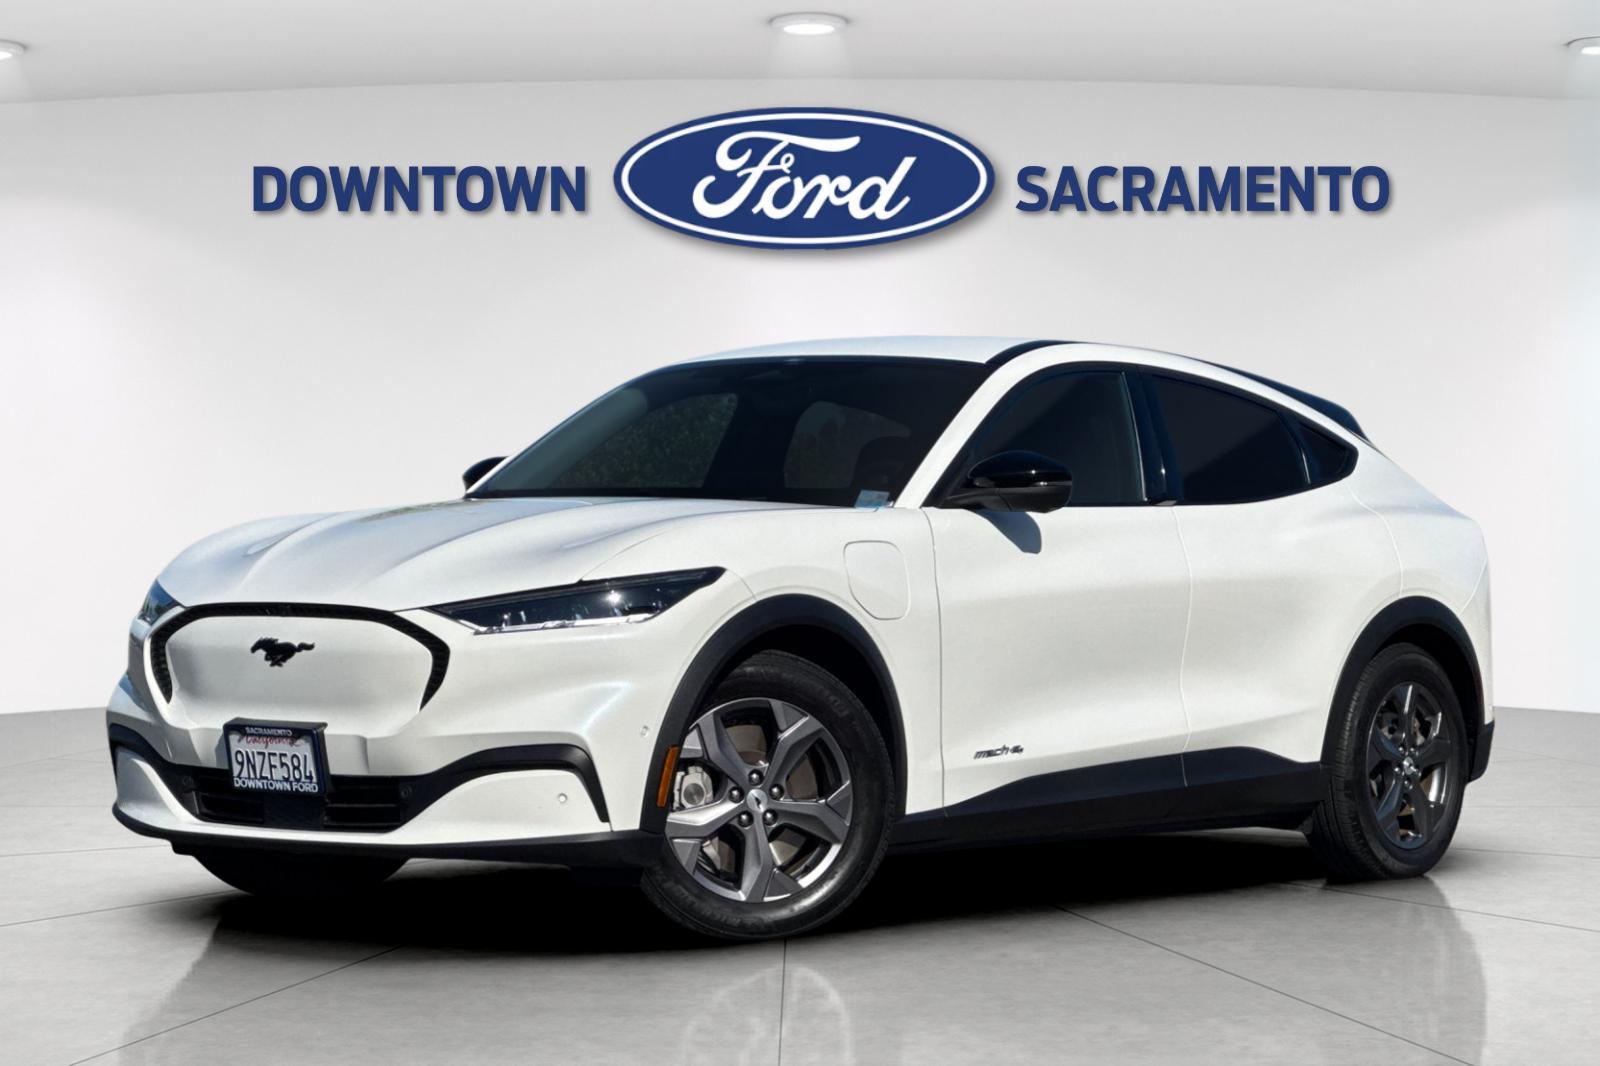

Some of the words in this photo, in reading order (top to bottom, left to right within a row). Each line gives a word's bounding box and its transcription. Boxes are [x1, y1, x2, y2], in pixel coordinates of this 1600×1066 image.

[252, 165, 587, 213] DOWNTOWN
[692, 131, 918, 220] Ford
[1015, 165, 1391, 213] SACRAMENTO
[245, 727, 293, 736] SACRAMENTO
[234, 750, 314, 782] 9NZF584
[234, 778, 291, 790] DOWNTOWN
[292, 783, 319, 792] FORD
